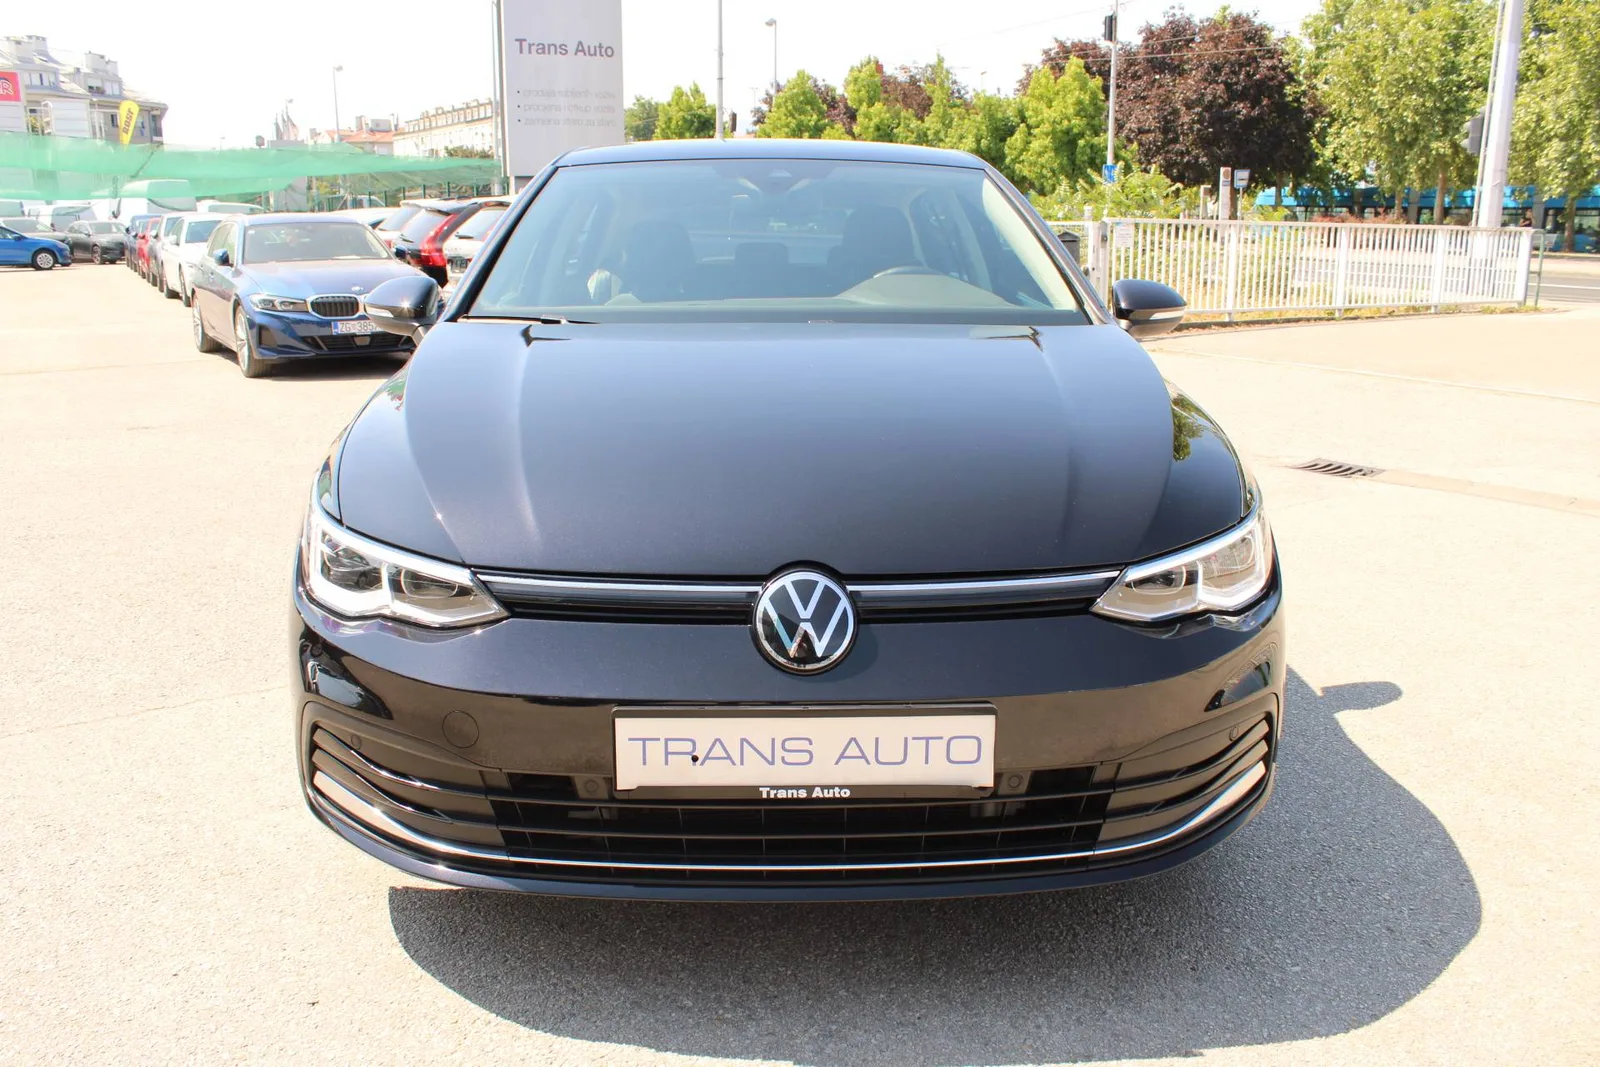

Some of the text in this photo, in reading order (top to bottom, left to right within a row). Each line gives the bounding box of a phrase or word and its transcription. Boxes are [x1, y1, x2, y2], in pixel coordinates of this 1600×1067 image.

[514, 38, 615, 57] Trans Auto
[340, 322, 351, 333] ZG
[627, 735, 983, 767] TRANS AUTO
[758, 786, 851, 799] Trans Auto
